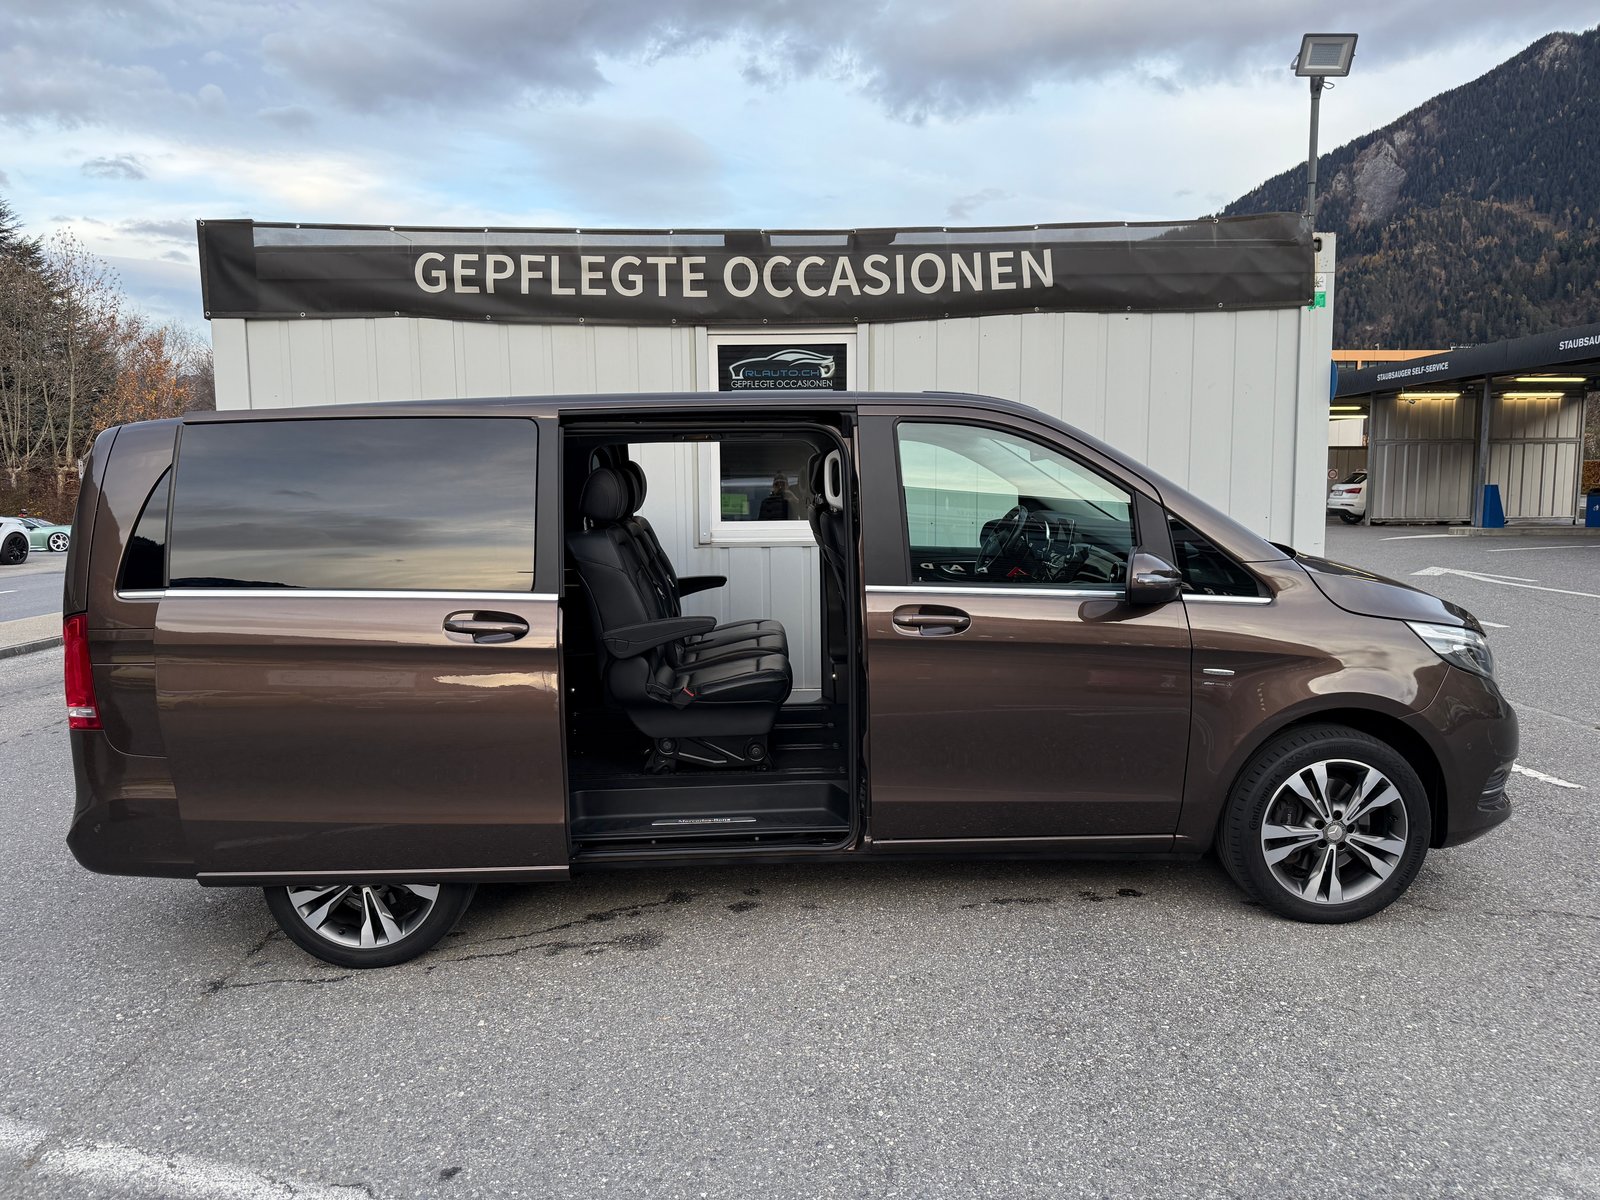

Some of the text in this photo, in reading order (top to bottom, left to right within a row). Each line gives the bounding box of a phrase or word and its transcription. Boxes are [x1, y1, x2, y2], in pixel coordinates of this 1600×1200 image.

[414, 248, 1054, 298] GEPFLEGTE OCCASIONEN
[745, 369, 820, 377] RLAUTO.CH
[1376, 361, 1449, 382] STAUBSAUGER SELF-SERVICE
[731, 379, 833, 388] GEPFLEGTE OCCASIONEN
